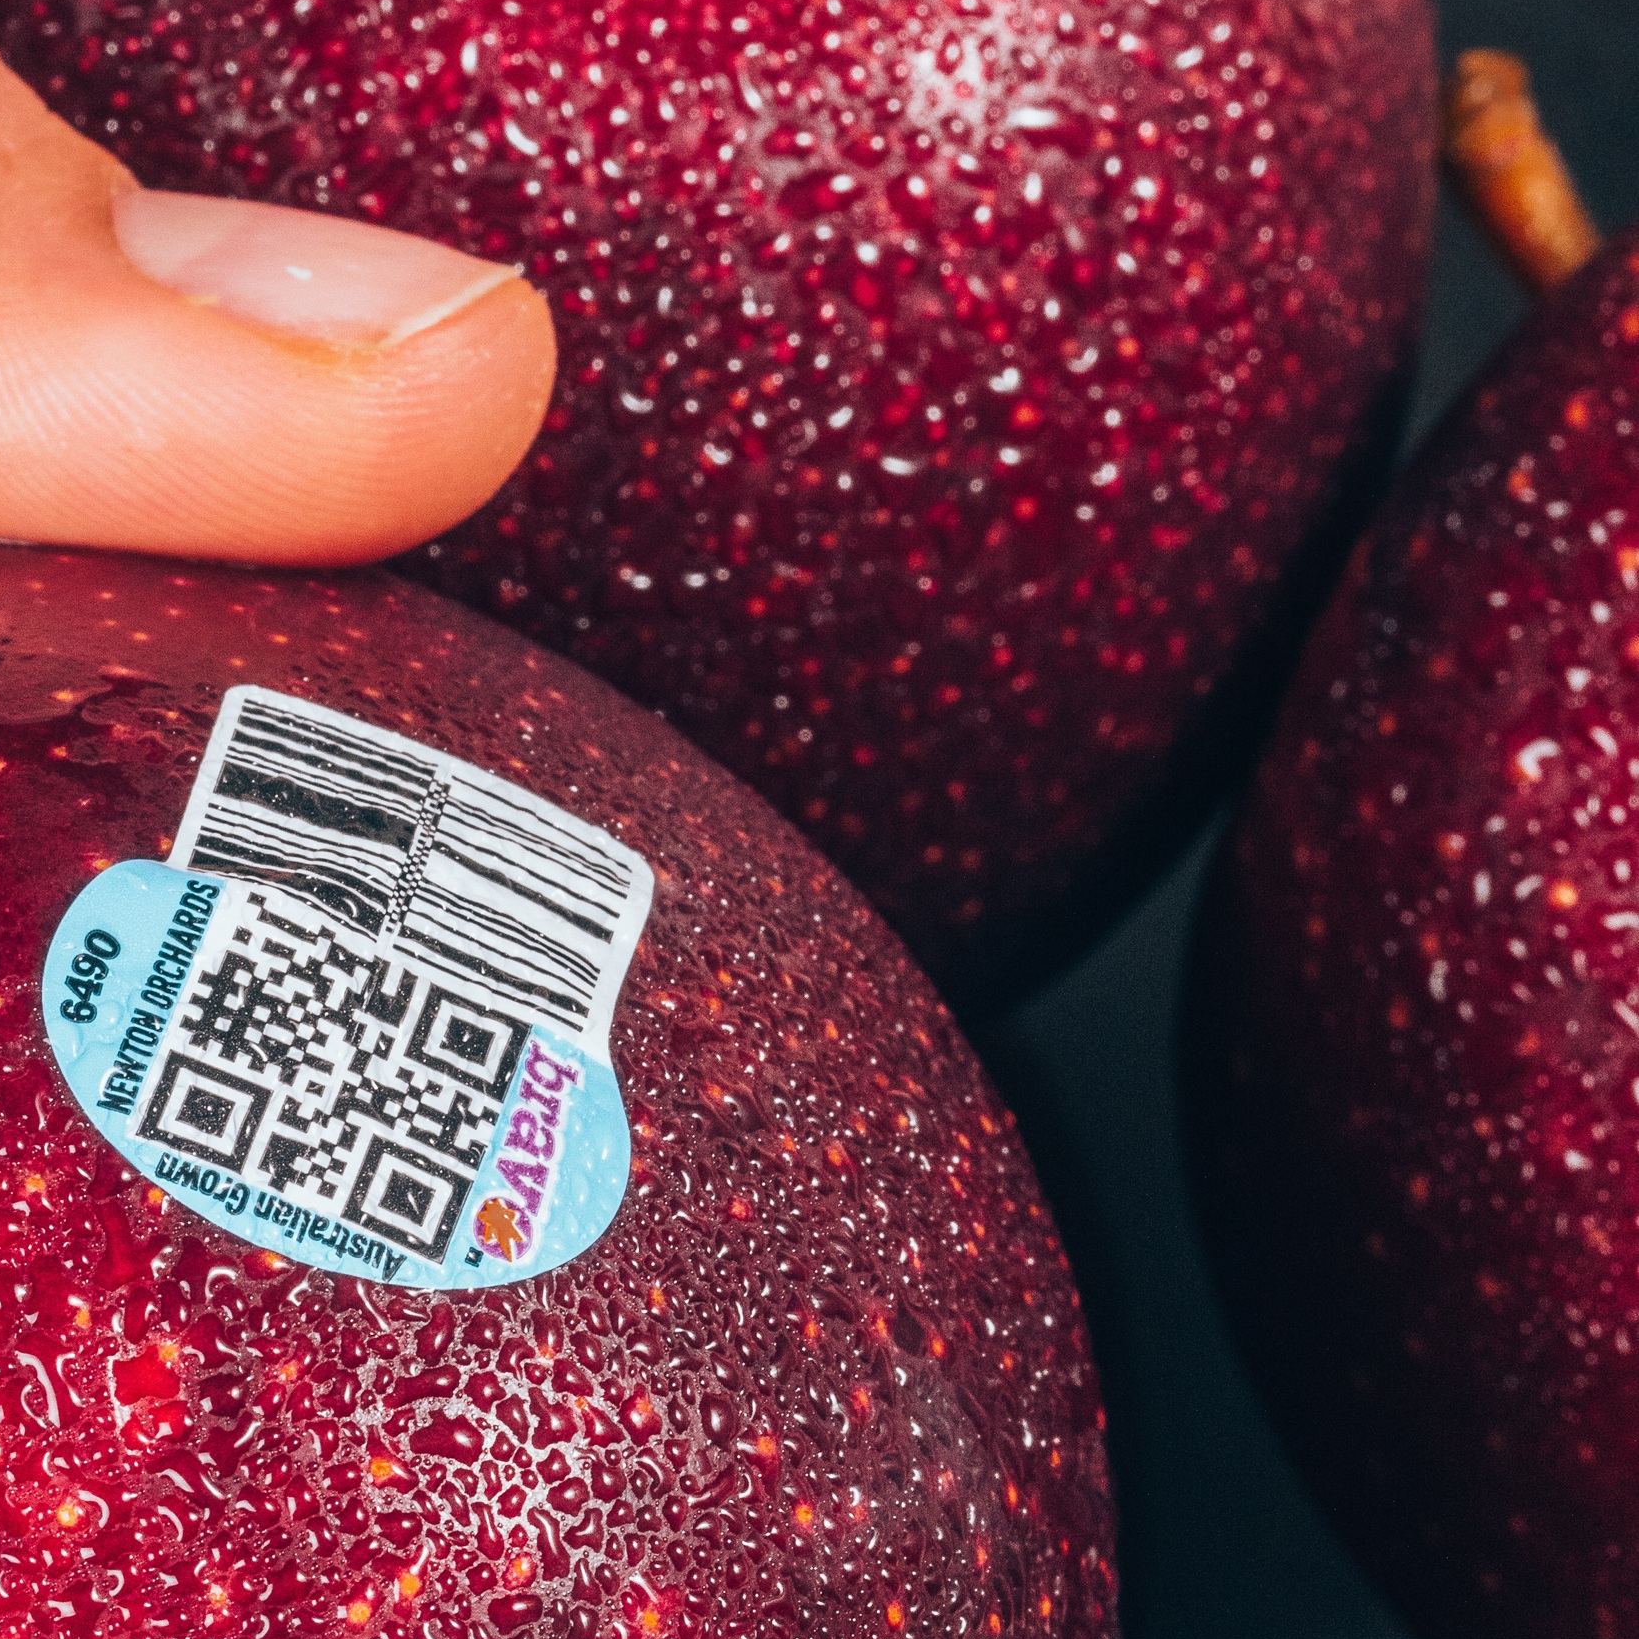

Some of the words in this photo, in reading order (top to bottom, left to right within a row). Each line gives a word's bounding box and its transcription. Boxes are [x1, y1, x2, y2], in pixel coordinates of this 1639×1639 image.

[60, 929, 121, 1024] 6490
[97, 1007, 168, 1115] NEWTON
[141, 879, 221, 1010] ORCHARDS
[155, 1152, 250, 1216] Grown
[253, 1191, 407, 1283] Australian
